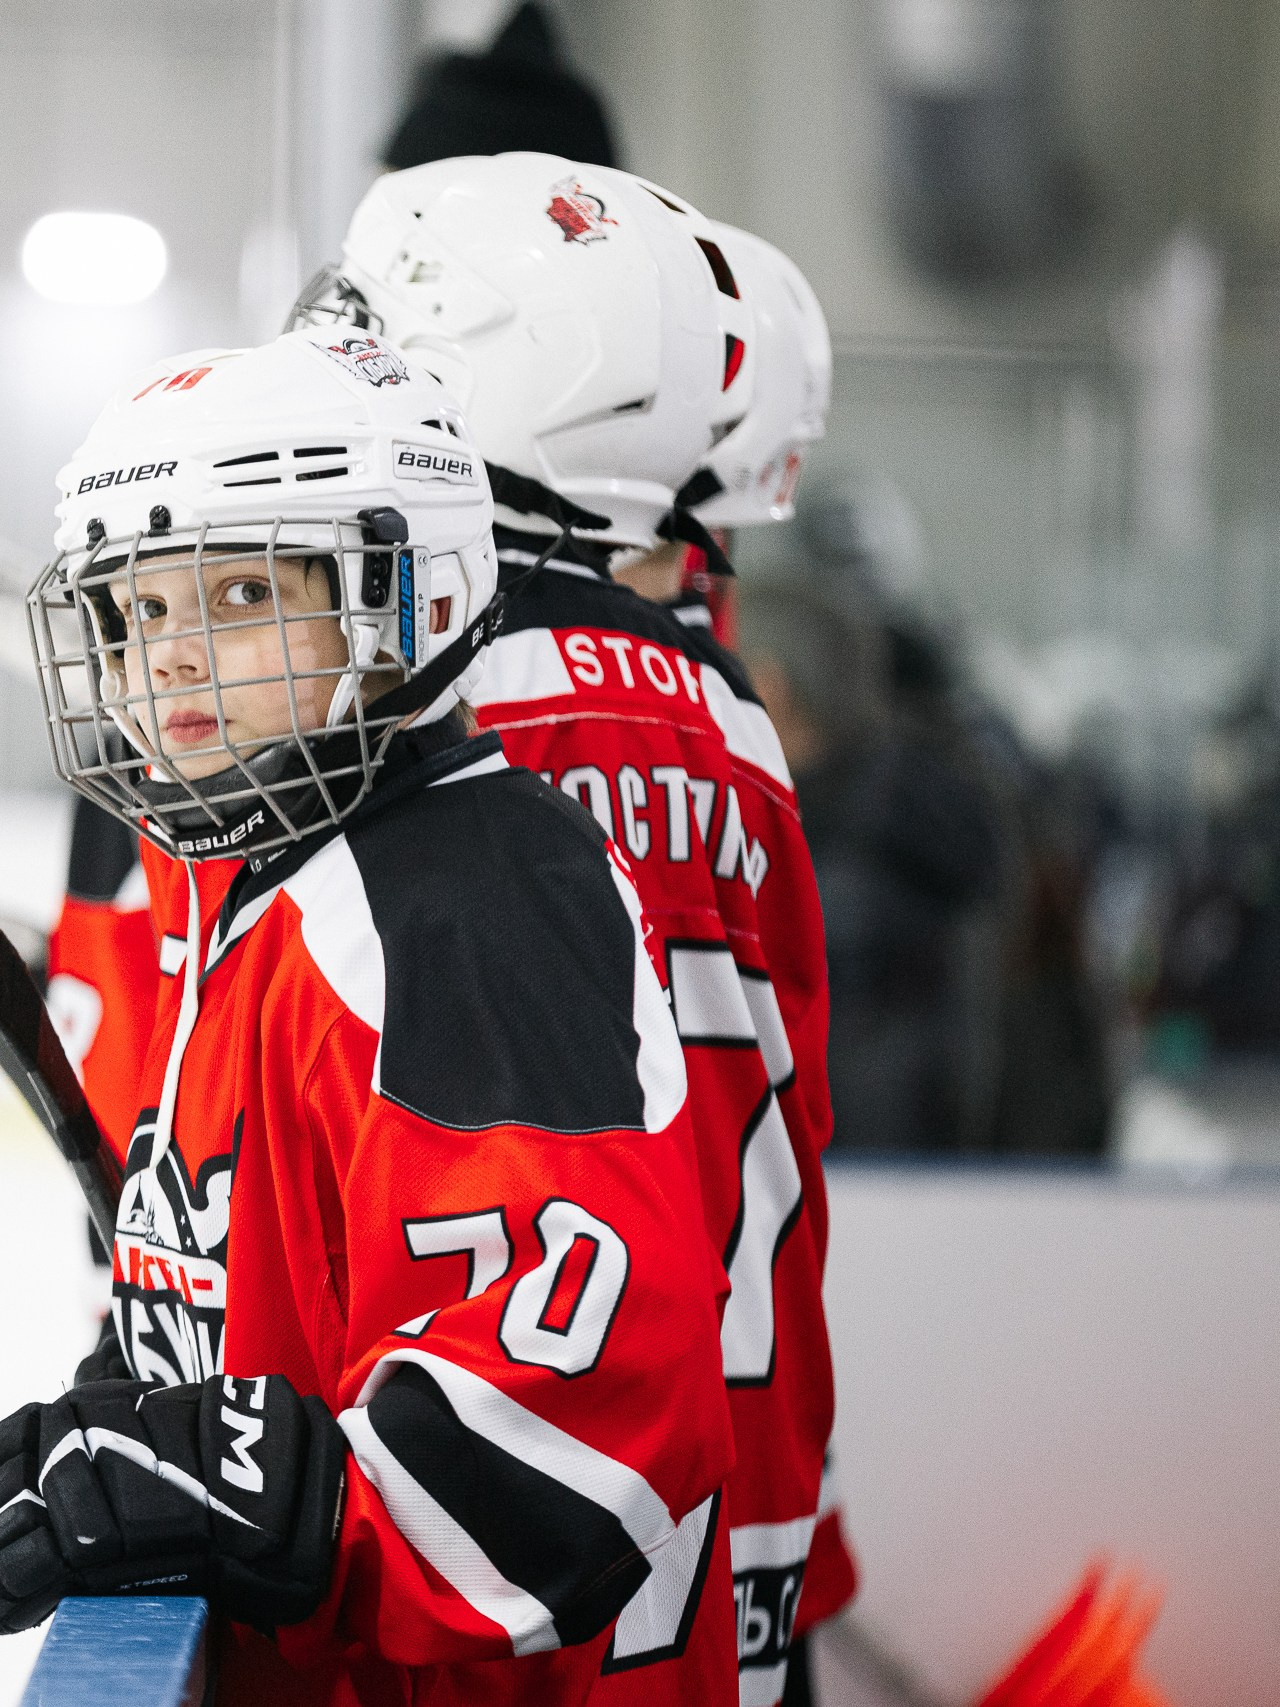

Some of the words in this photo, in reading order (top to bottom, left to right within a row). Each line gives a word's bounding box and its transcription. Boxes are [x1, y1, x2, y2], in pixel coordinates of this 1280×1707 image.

[77, 460, 179, 496] BAUER
[397, 450, 474, 479] BAUER
[400, 554, 413, 659] BAUER
[178, 809, 265, 853] BAUER
[391, 1196, 632, 1381] 70
